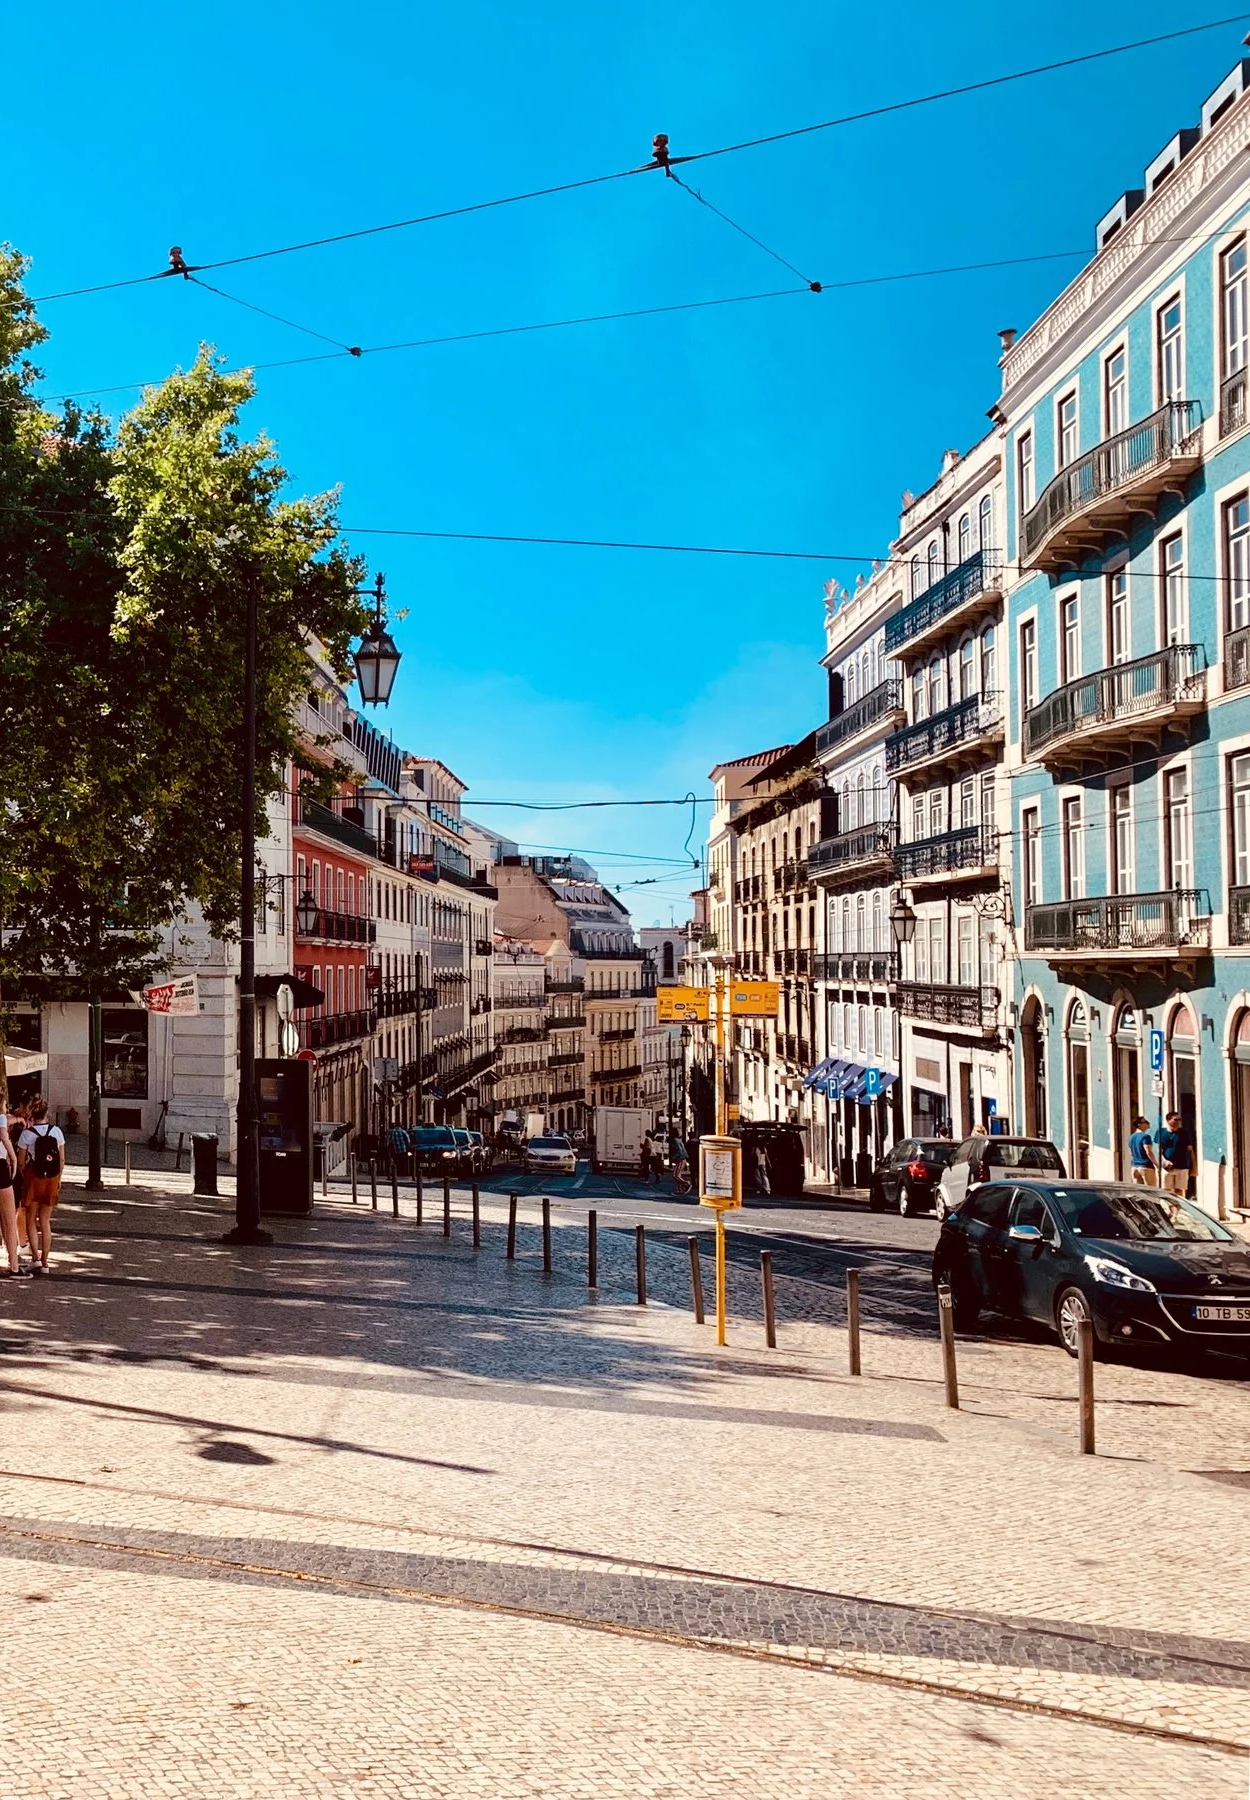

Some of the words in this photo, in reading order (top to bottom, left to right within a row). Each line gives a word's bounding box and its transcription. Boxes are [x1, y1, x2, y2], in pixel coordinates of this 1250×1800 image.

[1152, 1033, 1161, 1066] P
[830, 1080, 836, 1097] P
[869, 1071, 876, 1091] P
